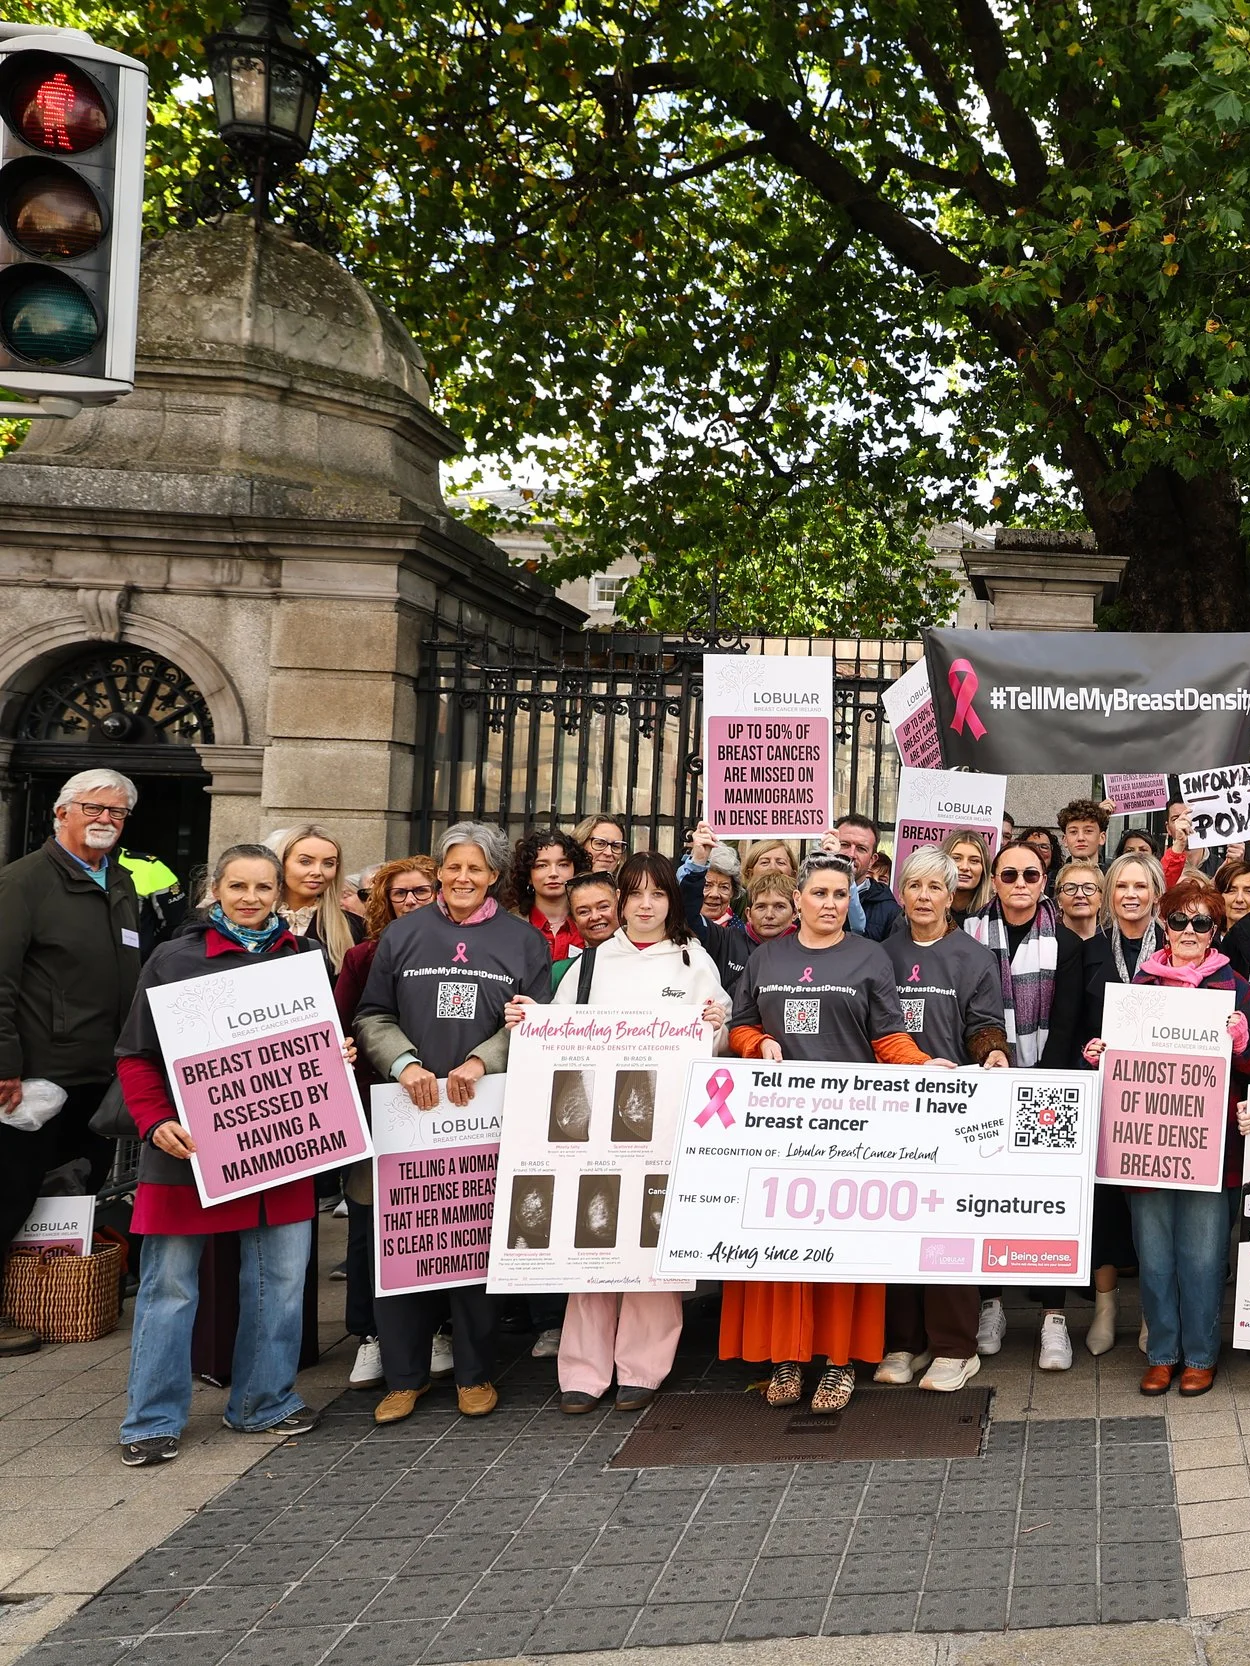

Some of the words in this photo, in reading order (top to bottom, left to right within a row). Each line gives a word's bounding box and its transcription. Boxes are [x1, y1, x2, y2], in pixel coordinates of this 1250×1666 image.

[753, 692, 819, 704] LOBULAR
[906, 682, 930, 707] LOBULA
[728, 723, 743, 739] UP
[746, 723, 761, 739] TO
[765, 723, 792, 739] 50%
[795, 723, 810, 739] OF
[903, 723, 911, 736] UP
[910, 719, 919, 730] TO
[717, 744, 763, 760] BREAST
[766, 744, 820, 761] CANCERS
[723, 766, 747, 782] ARE
[750, 766, 794, 782] MISSED
[798, 766, 813, 782] ON
[724, 787, 813, 804] MAMMOGRAMS
[714, 809, 725, 825] IN
[729, 809, 768, 825] DENSE
[771, 809, 823, 825] BREASTS
[937, 801, 992, 815] LOBULAR
[901, 825, 945, 842] BREAST
[403, 966, 515, 985] #TellMeMyBreastDensity
[759, 984, 857, 997] TellMeMyBreastDensity
[226, 996, 316, 1029] LOBULAR
[231, 1026, 258, 1038] BREAST
[260, 1018, 289, 1031] CANCER
[289, 1011, 318, 1023] IRELAND
[1151, 1026, 1218, 1042] LOBULAR
[181, 1049, 252, 1085] BREAST
[257, 1028, 330, 1065] DENSITY
[207, 1078, 246, 1105] CAN
[249, 1065, 292, 1093] ONLY
[297, 1058, 323, 1080] BE
[1112, 1058, 1177, 1084] ALMOST
[1180, 1063, 1216, 1087] 50%
[751, 1071, 782, 1087] Tell
[787, 1076, 815, 1088] me
[820, 1077, 849, 1093] my
[853, 1074, 910, 1092] breast
[914, 1077, 978, 1098] density
[213, 1090, 304, 1132] ASSESSED
[306, 1081, 328, 1104] BY
[747, 1091, 805, 1109] before
[810, 1097, 843, 1113] you
[848, 1095, 876, 1111] tell
[881, 1100, 909, 1112] me
[915, 1098, 921, 1112] I
[926, 1097, 967, 1114] have
[1120, 1090, 1141, 1113] OF
[1145, 1091, 1204, 1117] WOMEN
[236, 1116, 304, 1151] HAVING
[308, 1111, 321, 1131] A
[432, 1115, 502, 1134] LOBULA
[744, 1111, 803, 1129] breast
[808, 1117, 869, 1131] cancer
[954, 1125, 980, 1137] SCAN
[981, 1118, 1005, 1132] HERE
[964, 1134, 977, 1144] TO
[978, 1129, 1000, 1142] SIGN
[1112, 1120, 1153, 1145] HAVE
[1157, 1123, 1209, 1149] DENSE
[221, 1129, 347, 1183] MAMMOGRAM
[685, 1146, 696, 1154] IN
[698, 1146, 762, 1156] RECOGNITION
[764, 1148, 780, 1157] OF:
[785, 1142, 826, 1157] Lobular
[828, 1142, 863, 1159] Breast
[862, 1146, 897, 1160] Cancer
[898, 1146, 939, 1163] Ireland
[398, 1158, 445, 1180] TELLING
[448, 1157, 456, 1175] A
[1119, 1152, 1194, 1180] BREASTS.
[389, 1185, 419, 1206] WITH
[422, 1181, 459, 1202] DENSE
[462, 1176, 496, 1198] BREAS
[678, 1194, 697, 1202] THE
[699, 1194, 721, 1203] SUM
[723, 1195, 739, 1203] OF:
[762, 1176, 944, 1225] 10,000+
[956, 1193, 1065, 1217] signatures
[24, 1222, 78, 1233] LOBULAR
[669, 1249, 702, 1258] MEMO:
[706, 1241, 758, 1269] Asking
[764, 1245, 799, 1260] since
[802, 1246, 834, 1263] 2016
[1010, 1251, 1038, 1265] Being
[1040, 1251, 1071, 1264] dense.
